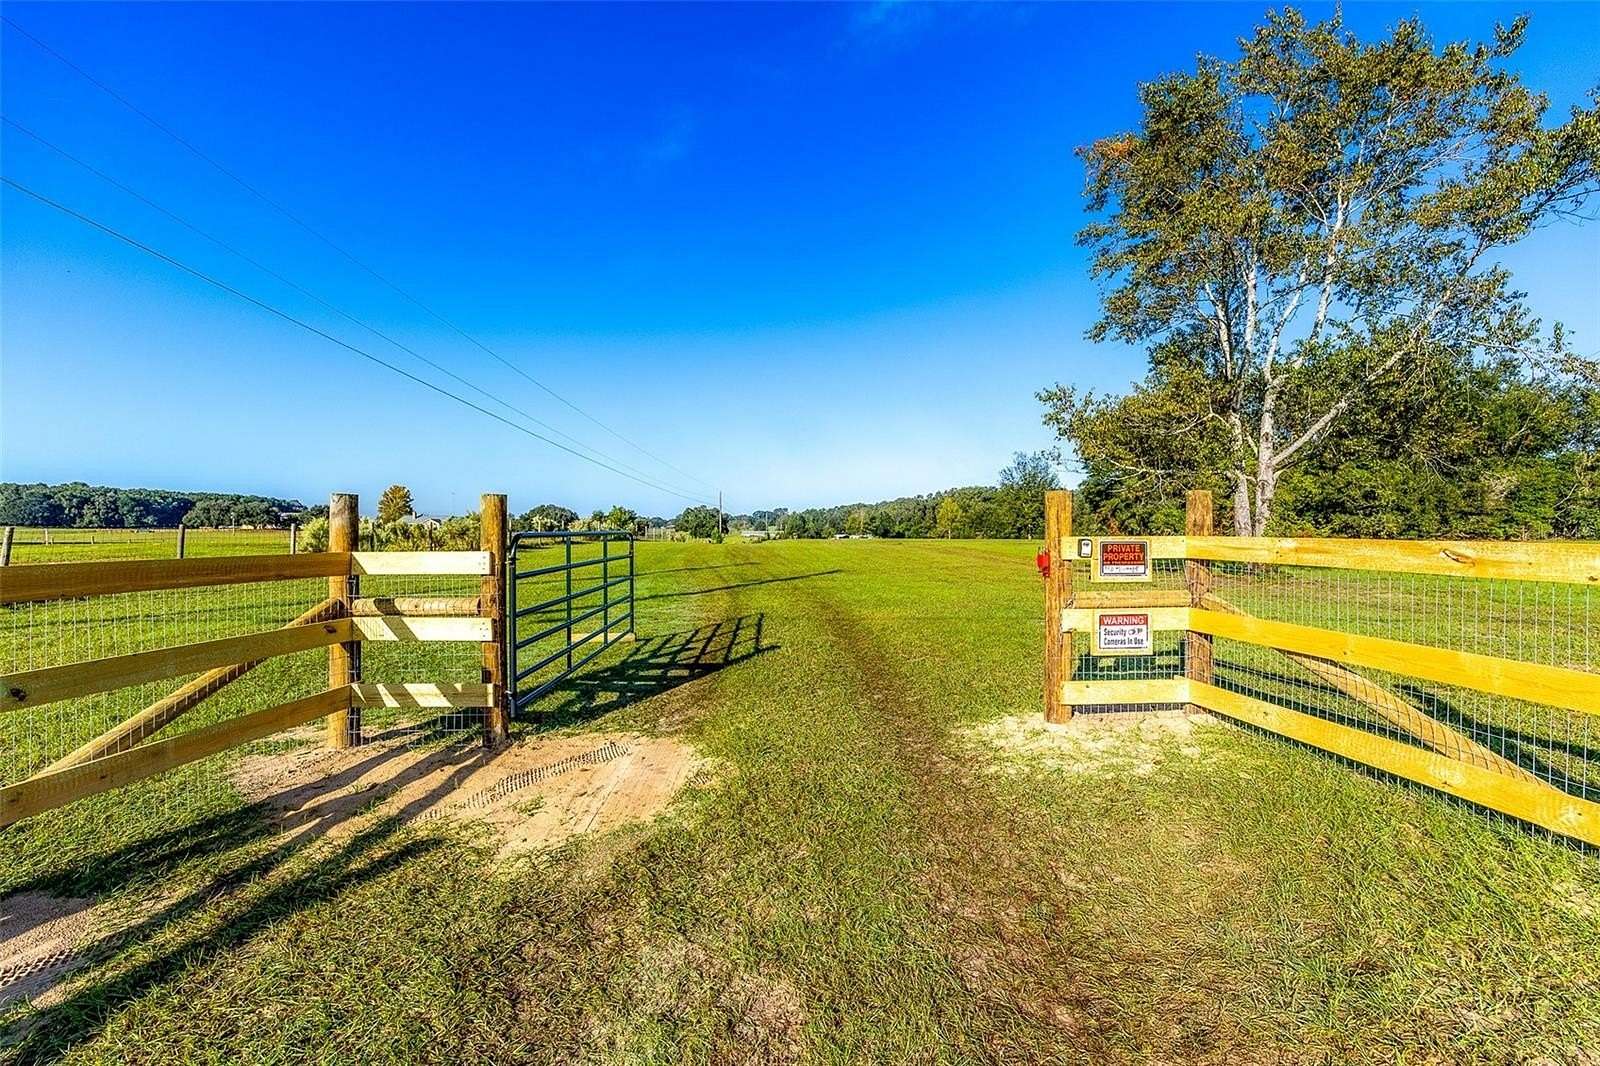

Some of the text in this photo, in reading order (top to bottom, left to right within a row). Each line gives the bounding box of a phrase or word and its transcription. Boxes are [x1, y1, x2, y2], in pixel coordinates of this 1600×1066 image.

[1107, 544, 1140, 552] PRIVATE
[1104, 615, 1144, 624] WARNING
[1103, 628, 1127, 636] Security
[1103, 637, 1126, 645] Cameras
[1134, 637, 1144, 645] Use
